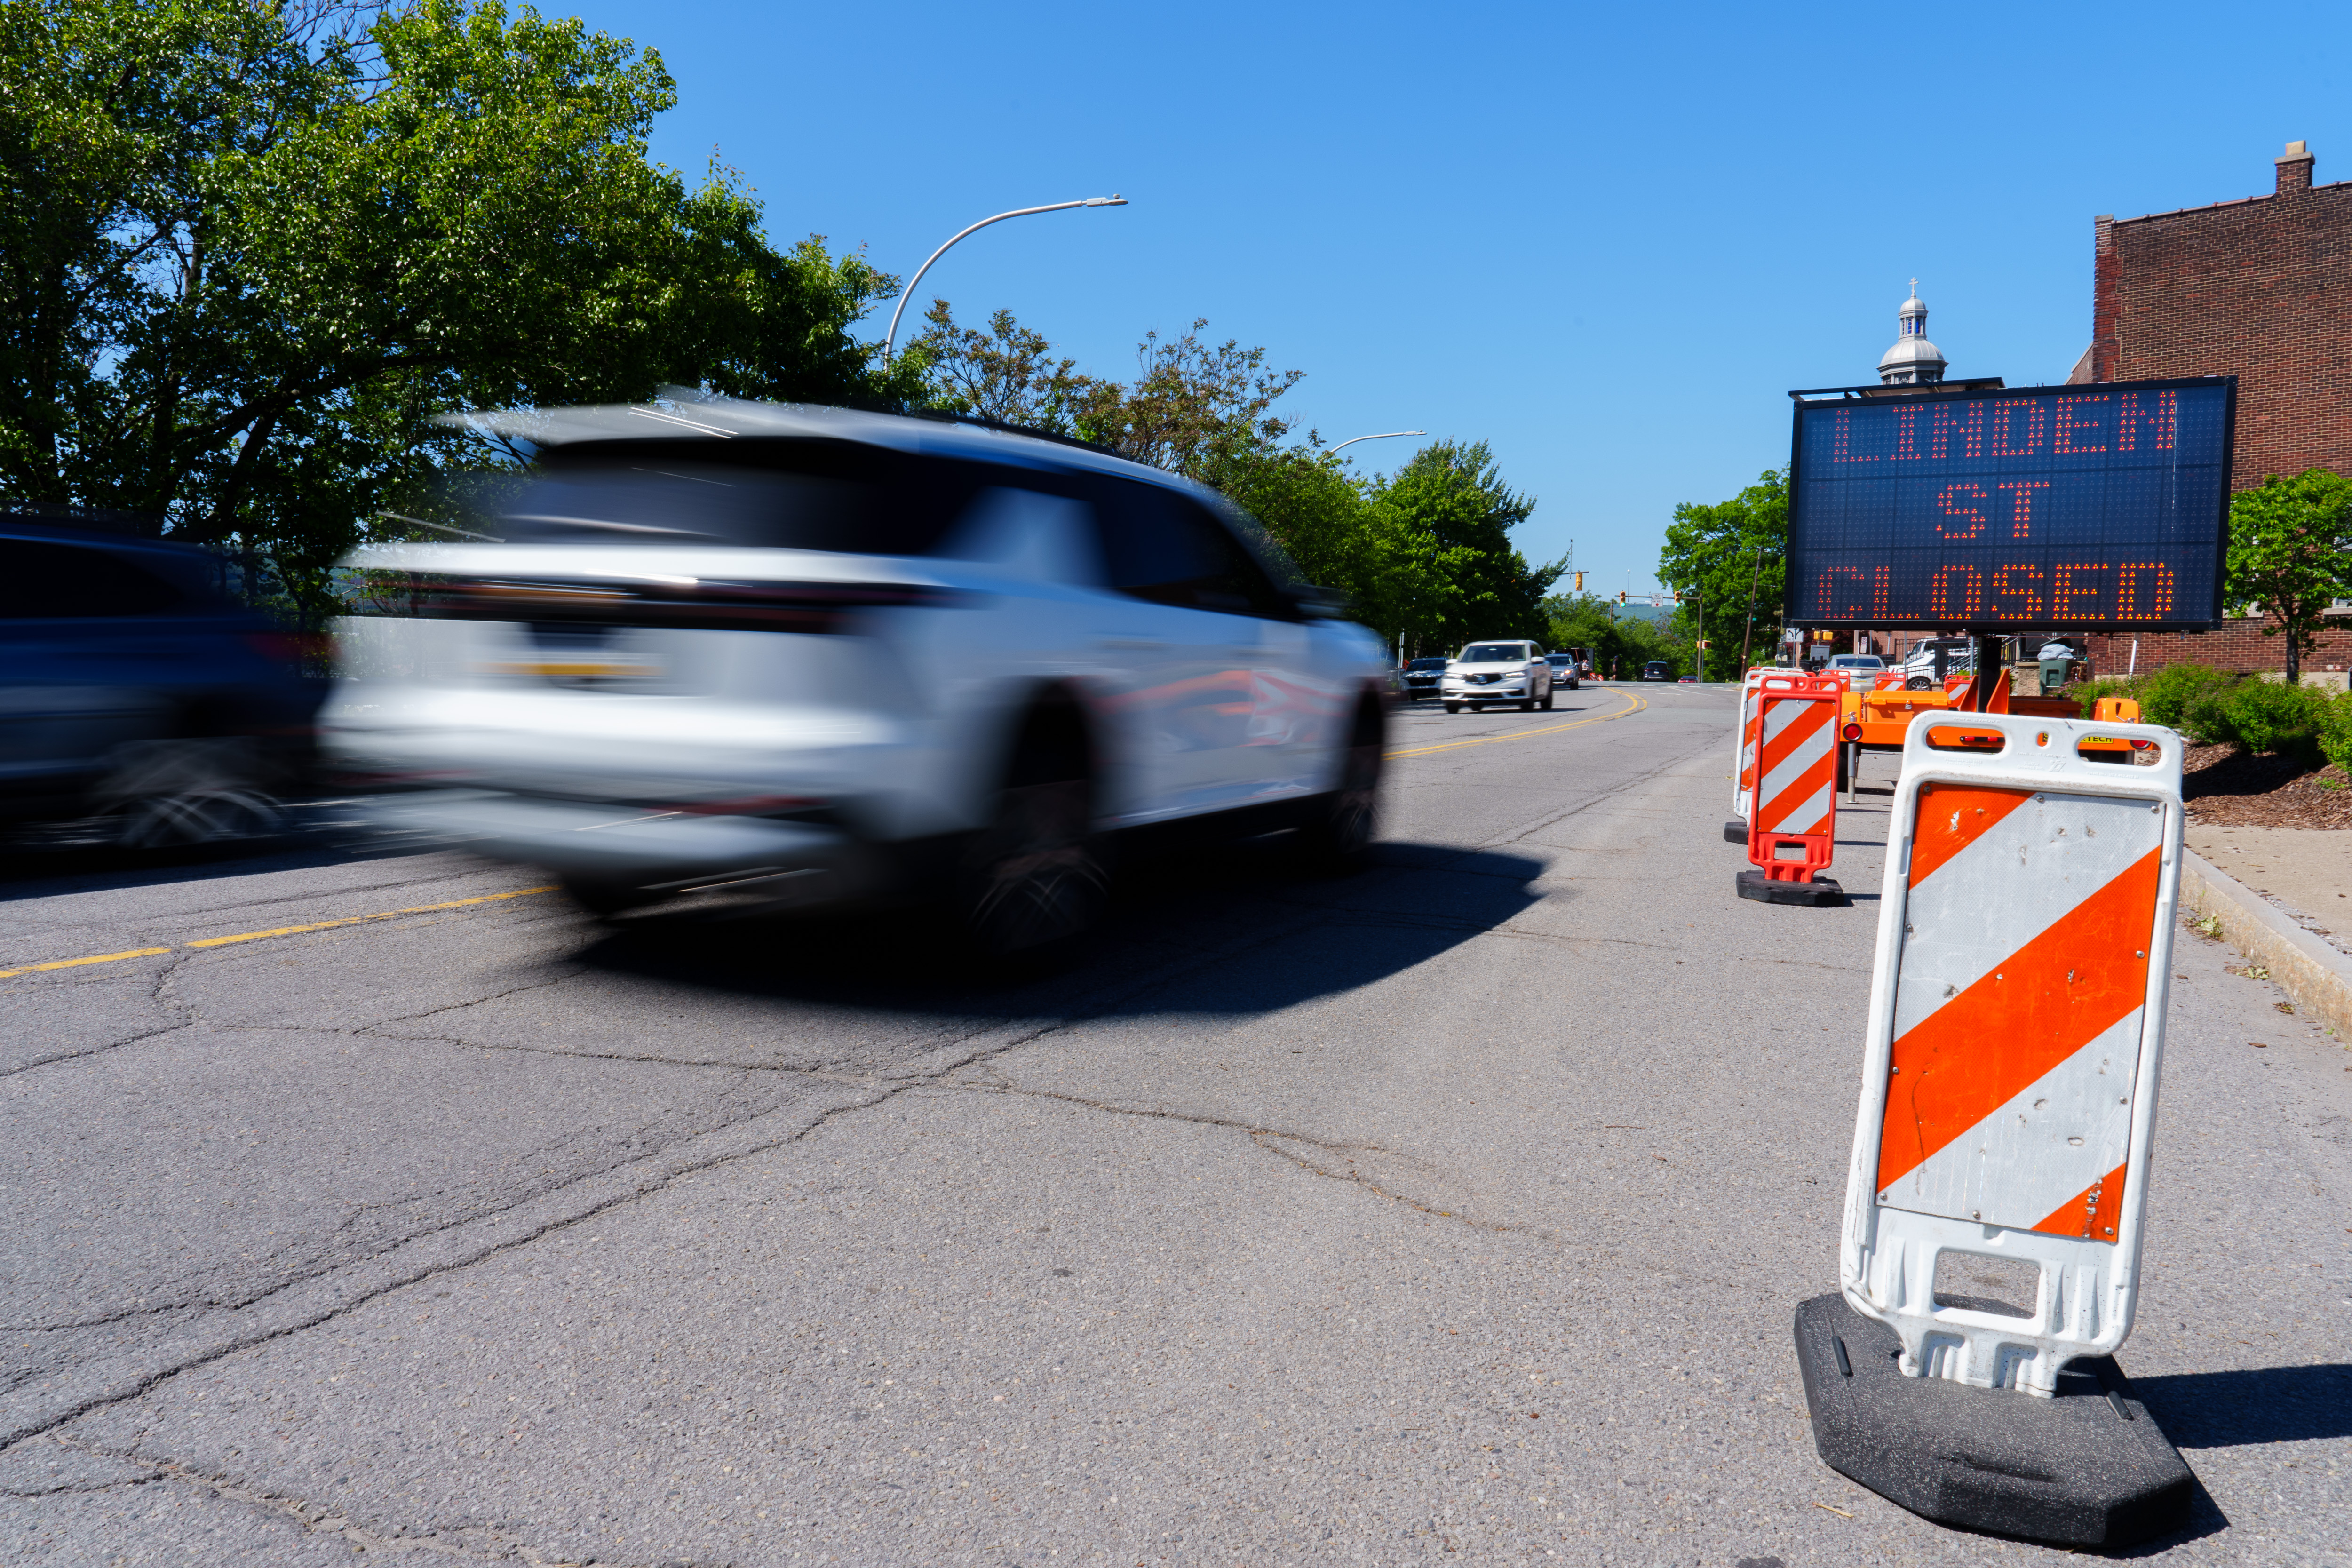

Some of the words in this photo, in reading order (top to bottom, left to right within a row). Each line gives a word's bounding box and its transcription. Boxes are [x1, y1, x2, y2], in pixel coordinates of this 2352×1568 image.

[1834, 391, 2176, 462] LINDEN
[1936, 482, 2050, 539] ST
[1818, 562, 2174, 620] CLOSED
